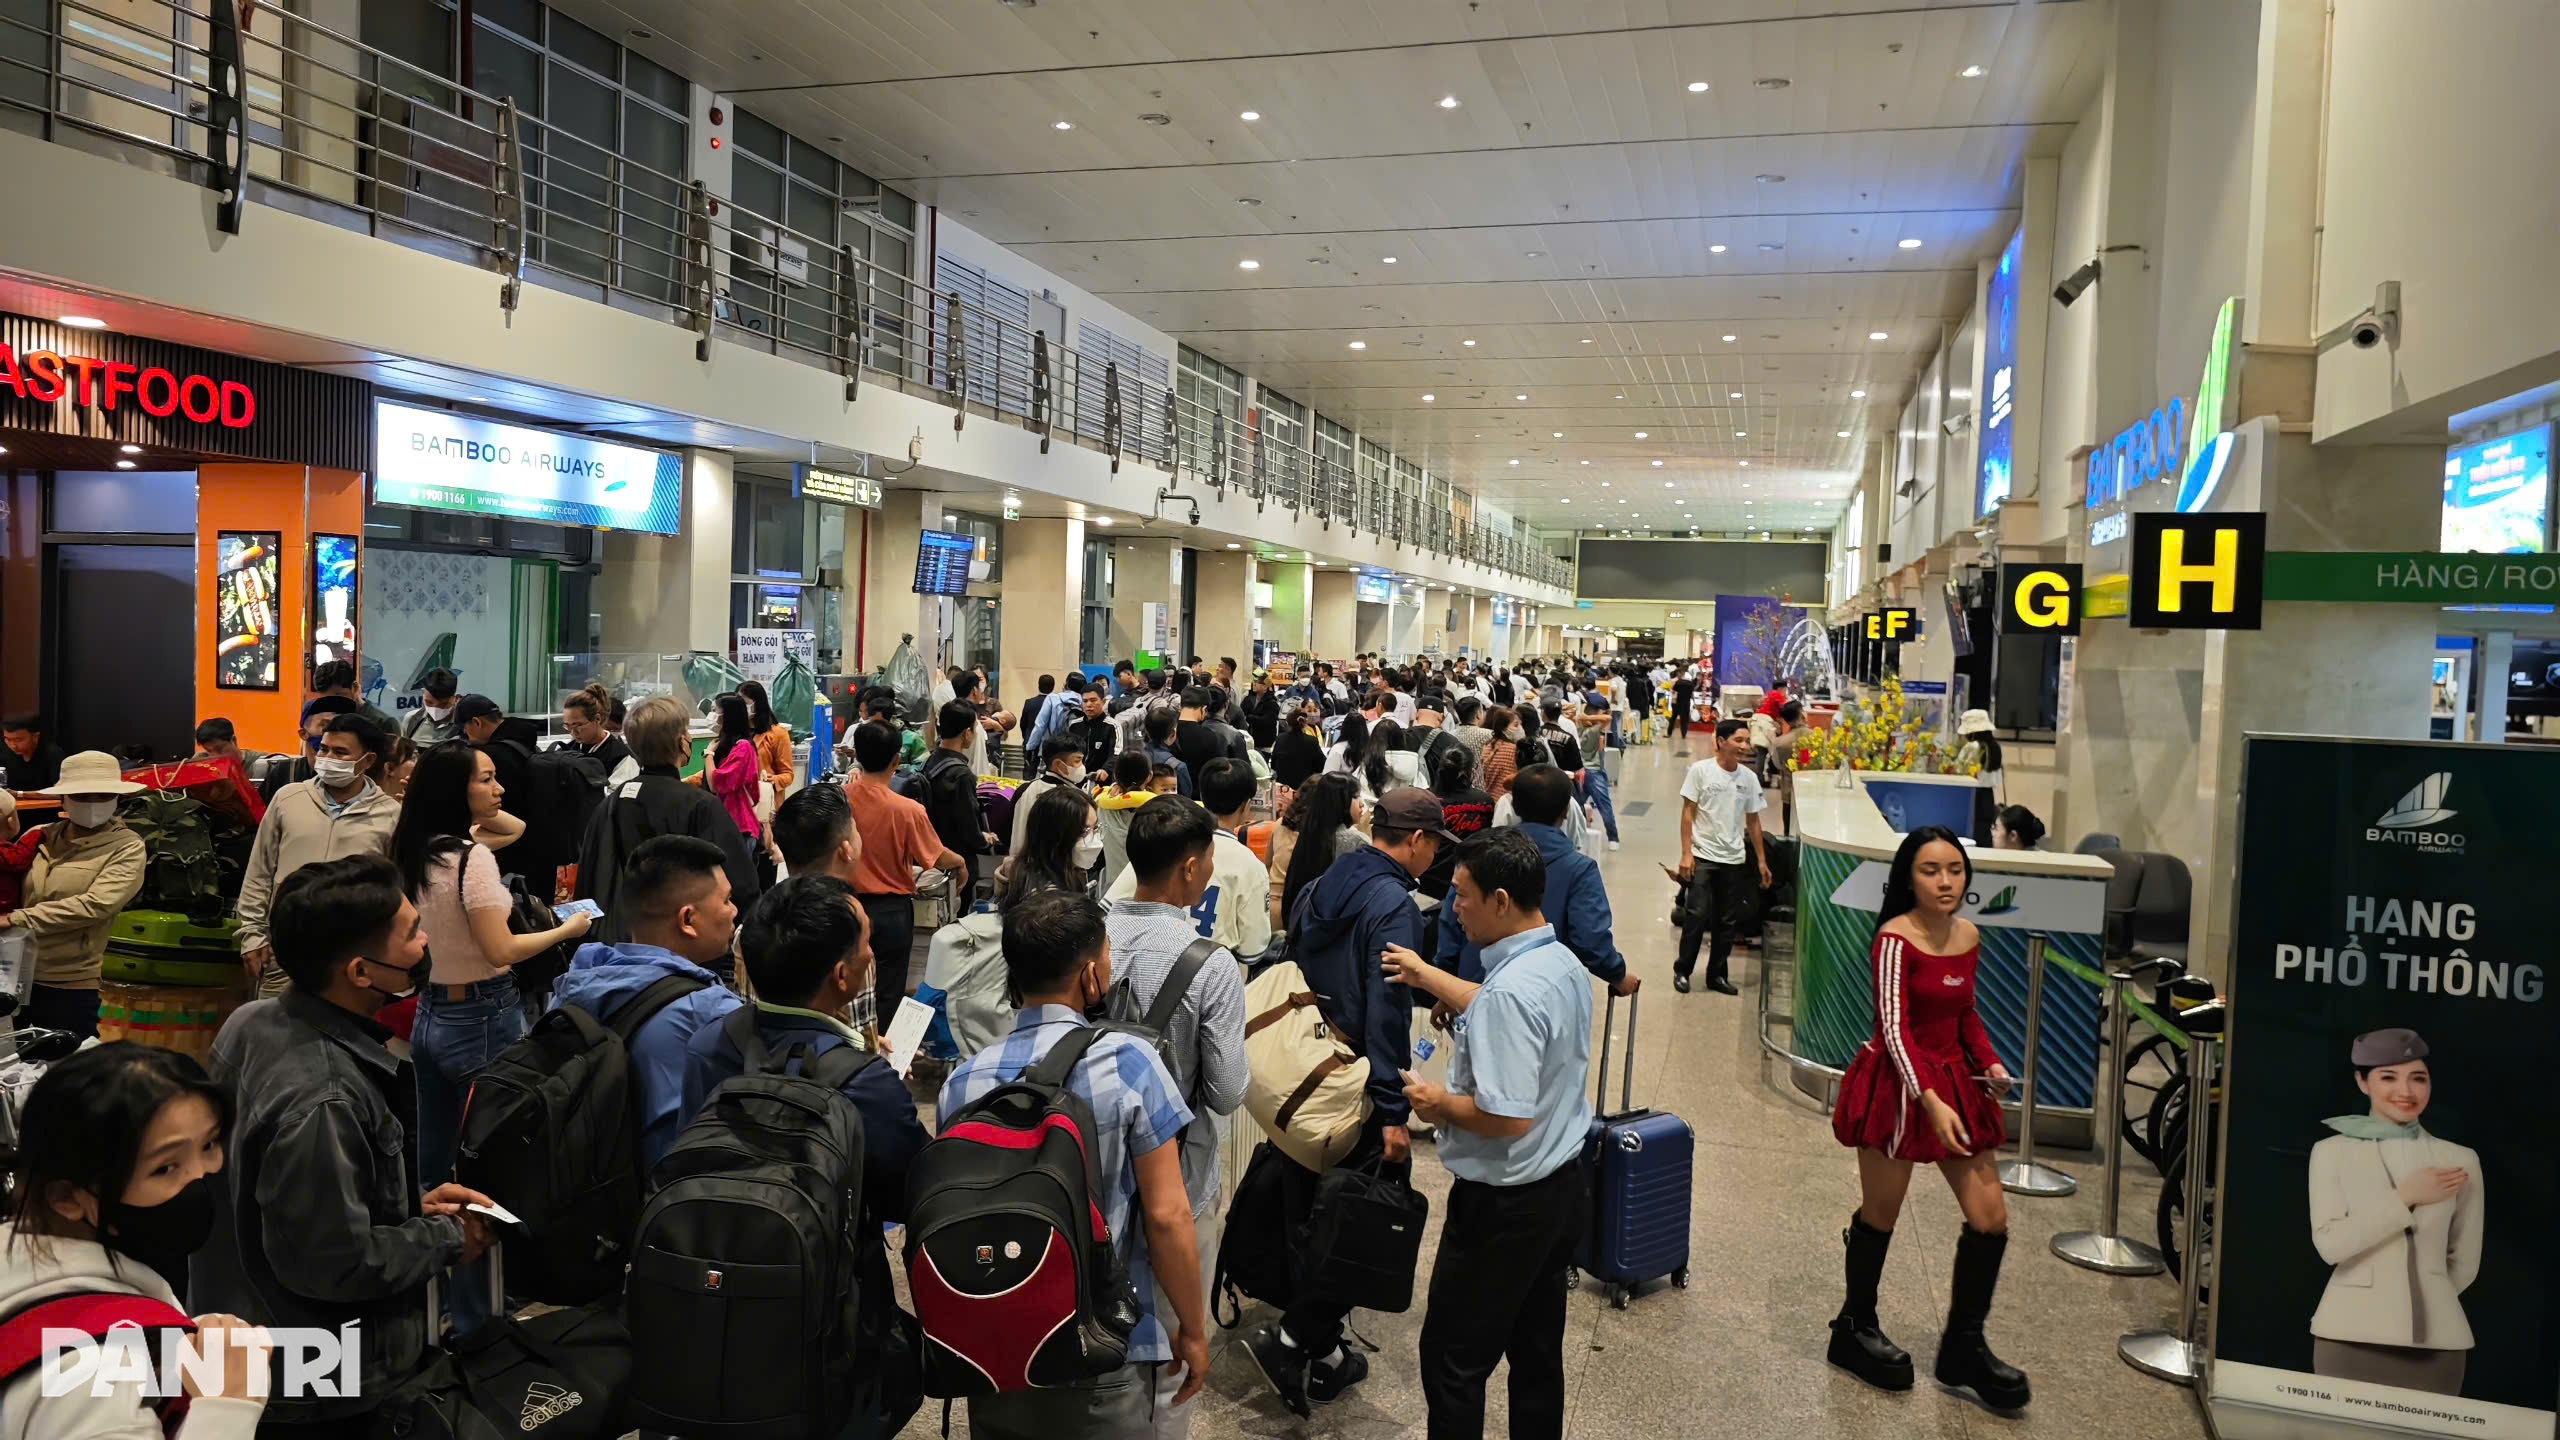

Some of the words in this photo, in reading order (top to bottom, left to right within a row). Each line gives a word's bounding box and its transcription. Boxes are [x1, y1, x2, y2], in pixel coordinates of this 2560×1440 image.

[411, 432, 511, 464] BAMBOO
[520, 450, 606, 479] AIRWAYS
[2085, 396, 2183, 510] BAMBOO
[445, 492, 465, 505] 1166
[2158, 528, 2239, 613] H
[2014, 570, 2070, 628] G
[1867, 615, 1881, 639] E
[1886, 610, 1909, 638] F
[2366, 828, 2466, 847] BAMBOO
[2417, 845, 2465, 855] AIRWAYS
[1190, 885, 1221, 938] 4
[2345, 895, 2477, 945] HẠNG
[2275, 934, 2368, 987] PHỔ
[2379, 947, 2545, 1003] THÔNG
[520, 1391, 583, 1431] adidas
[2286, 1386, 2309, 1398] 1900
[2310, 1390, 2332, 1401] 1166
[2345, 1395, 2486, 1426] www.bambooairways.com
